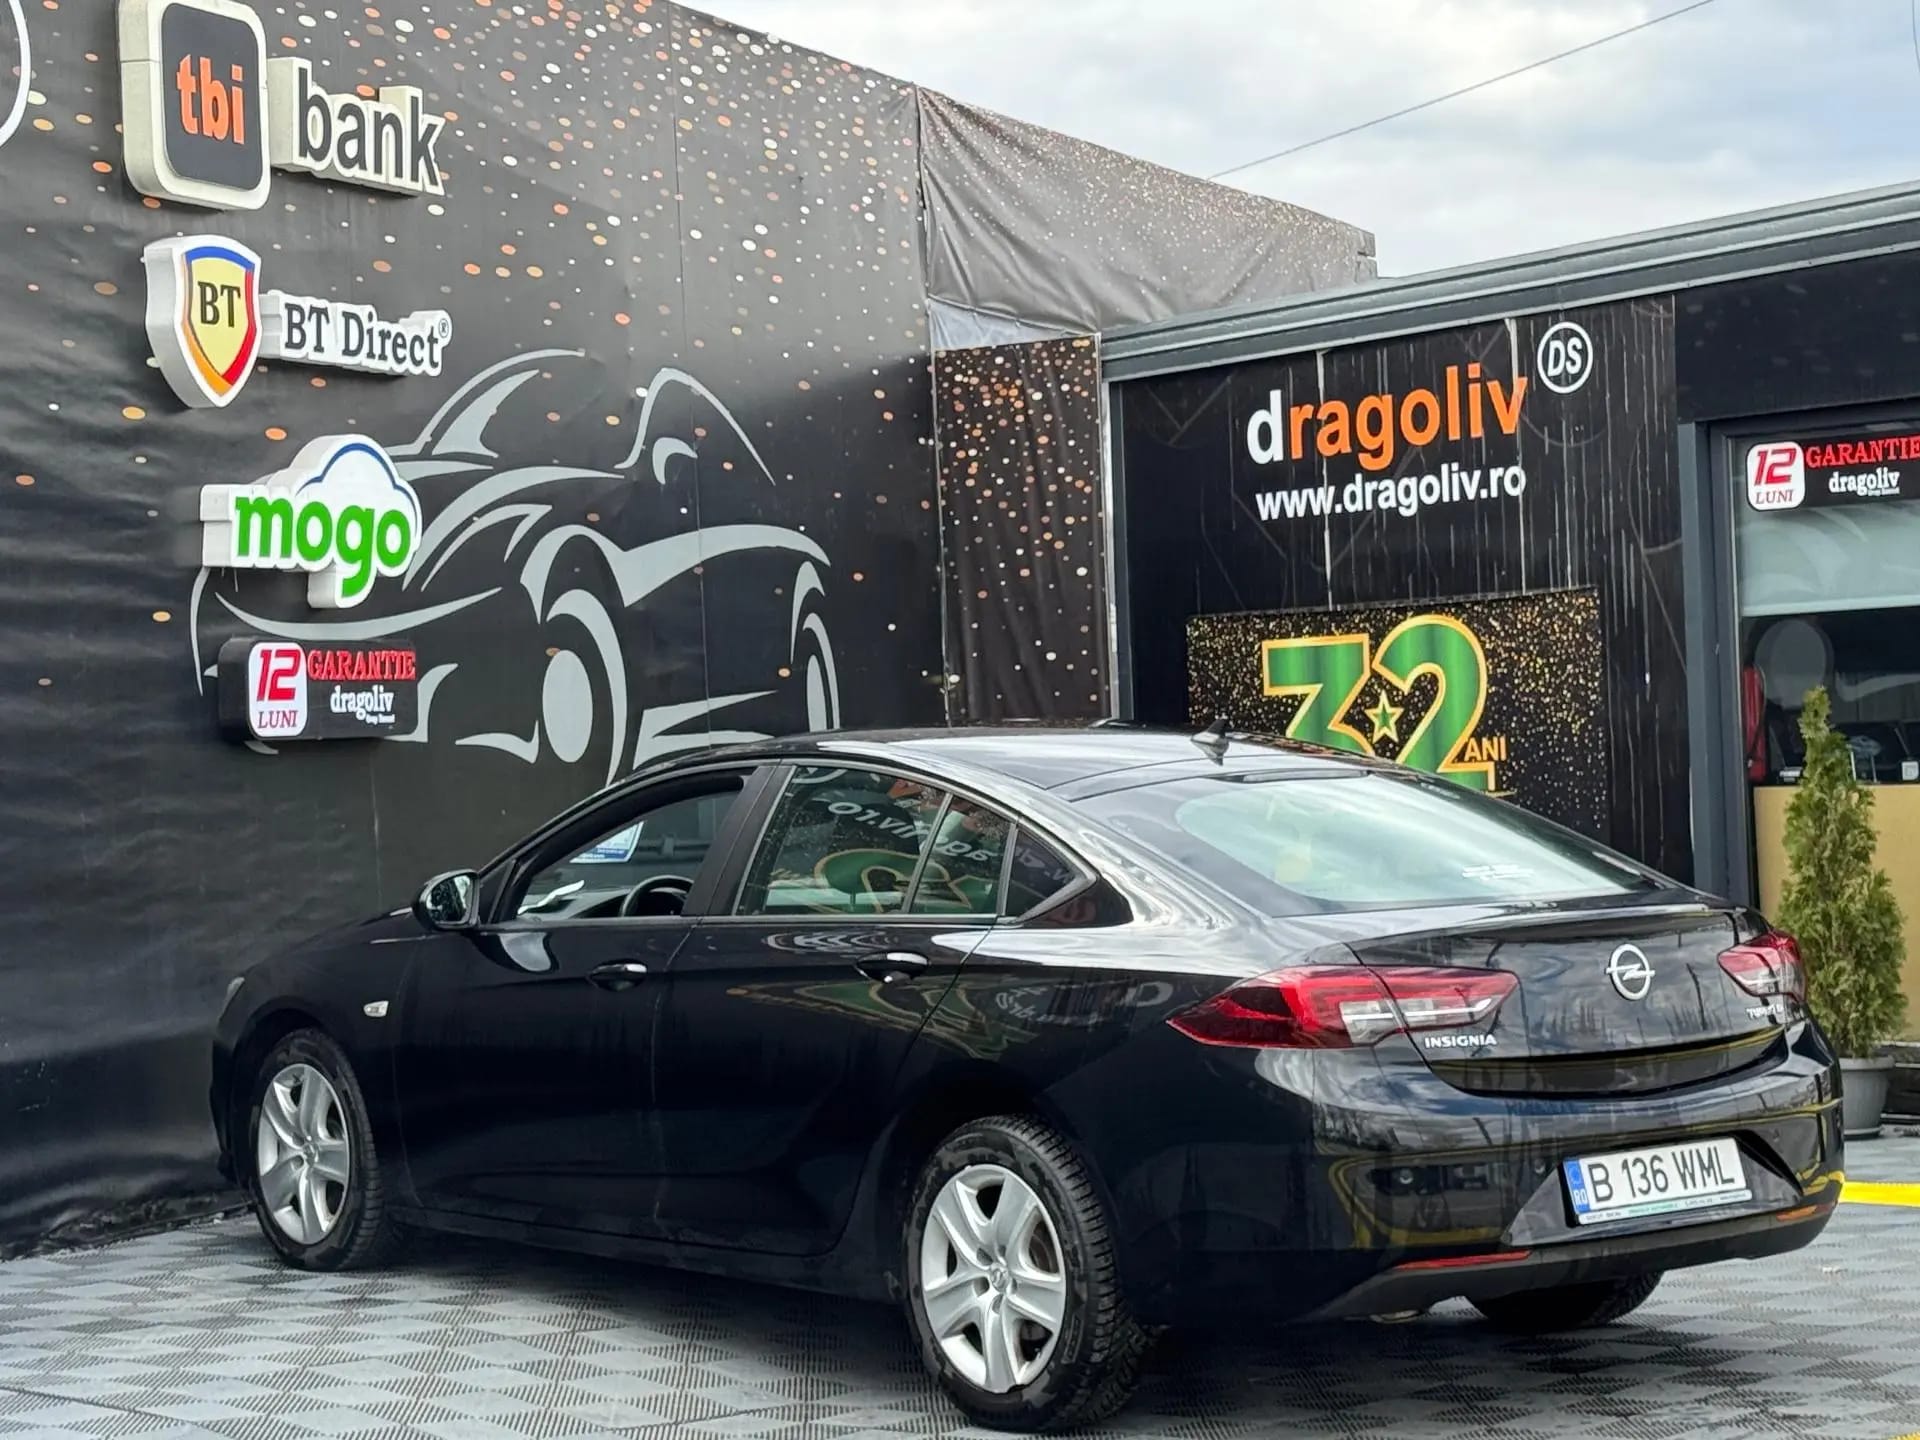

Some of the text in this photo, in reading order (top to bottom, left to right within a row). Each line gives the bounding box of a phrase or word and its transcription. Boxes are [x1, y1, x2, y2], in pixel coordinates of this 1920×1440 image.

[176, 54, 439, 187] tbi bank
[198, 281, 241, 328] BT
[285, 303, 330, 353] BT
[1547, 337, 1583, 377] DS
[1247, 362, 1528, 471] dragoliv
[1754, 434, 1920, 486] 12 GARANTIE
[1829, 467, 1900, 496] dragoliv
[1255, 462, 1526, 521] www.dragoliv.ro
[1755, 489, 1794, 504] LUNI
[235, 496, 411, 598] mogo
[256, 649, 416, 702] 12 GARANTIE
[257, 710, 298, 729] LUNI
[330, 684, 394, 720] dragoliv
[1261, 614, 1488, 793] 32
[1463, 737, 1506, 762] ANI
[1424, 1033, 1498, 1049] INSIGNIA
[1588, 1163, 1613, 1203] B
[1621, 1154, 1669, 1198] 136
[1672, 1146, 1735, 1190] WML
